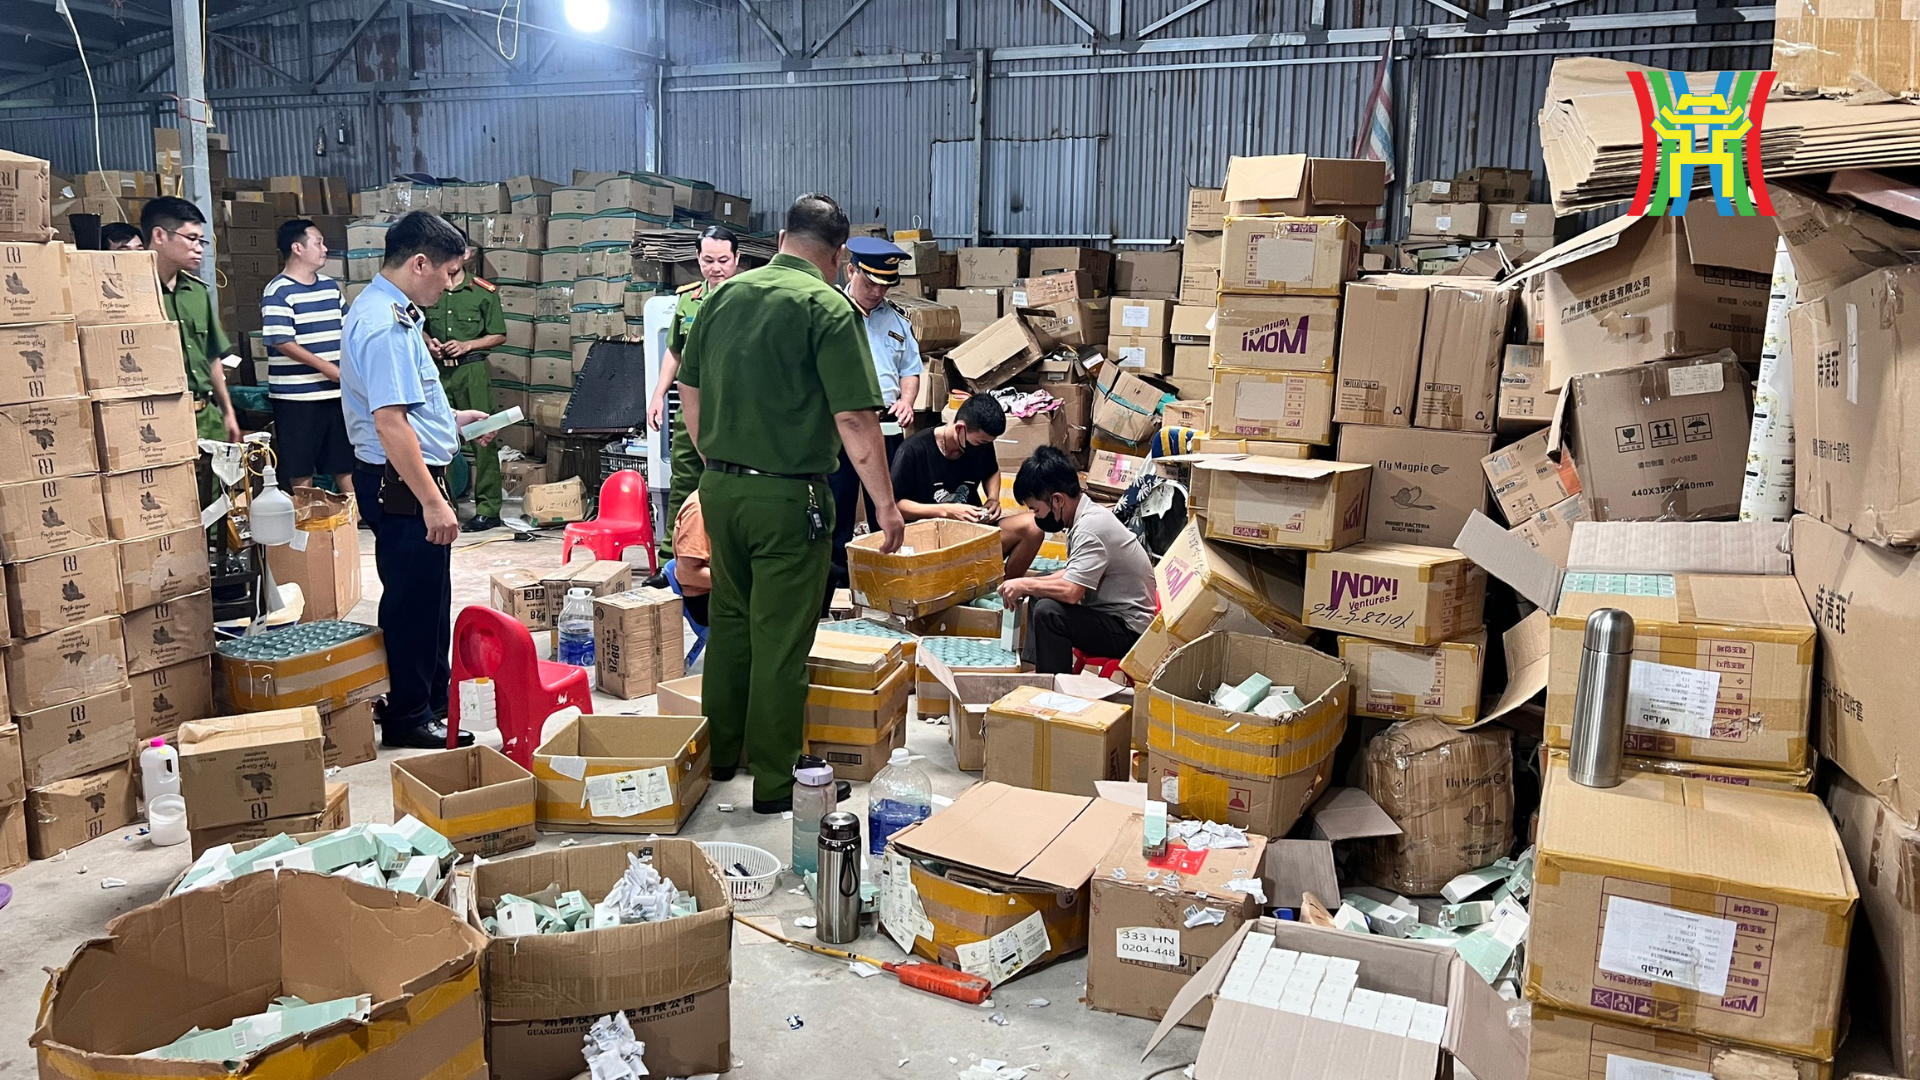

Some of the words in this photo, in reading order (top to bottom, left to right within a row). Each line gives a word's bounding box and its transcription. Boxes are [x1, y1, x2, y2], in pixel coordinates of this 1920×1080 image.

[1250, 317, 1290, 336] Ventures
[1379, 460, 1392, 471] Fly
[1394, 461, 1429, 474] Magpie
[1404, 521, 1430, 529] BACTERIA
[1348, 593, 1391, 611] Ventures
[1643, 713, 1671, 726] W.Lab
[1122, 931, 1147, 942] 333
[1152, 935, 1175, 945] HN
[1121, 943, 1176, 957] 0204-448
[1640, 964, 1674, 979] W.Lab
[527, 1026, 579, 1037] GUANGZHOU
[628, 1012, 667, 1025] OSMETIC
